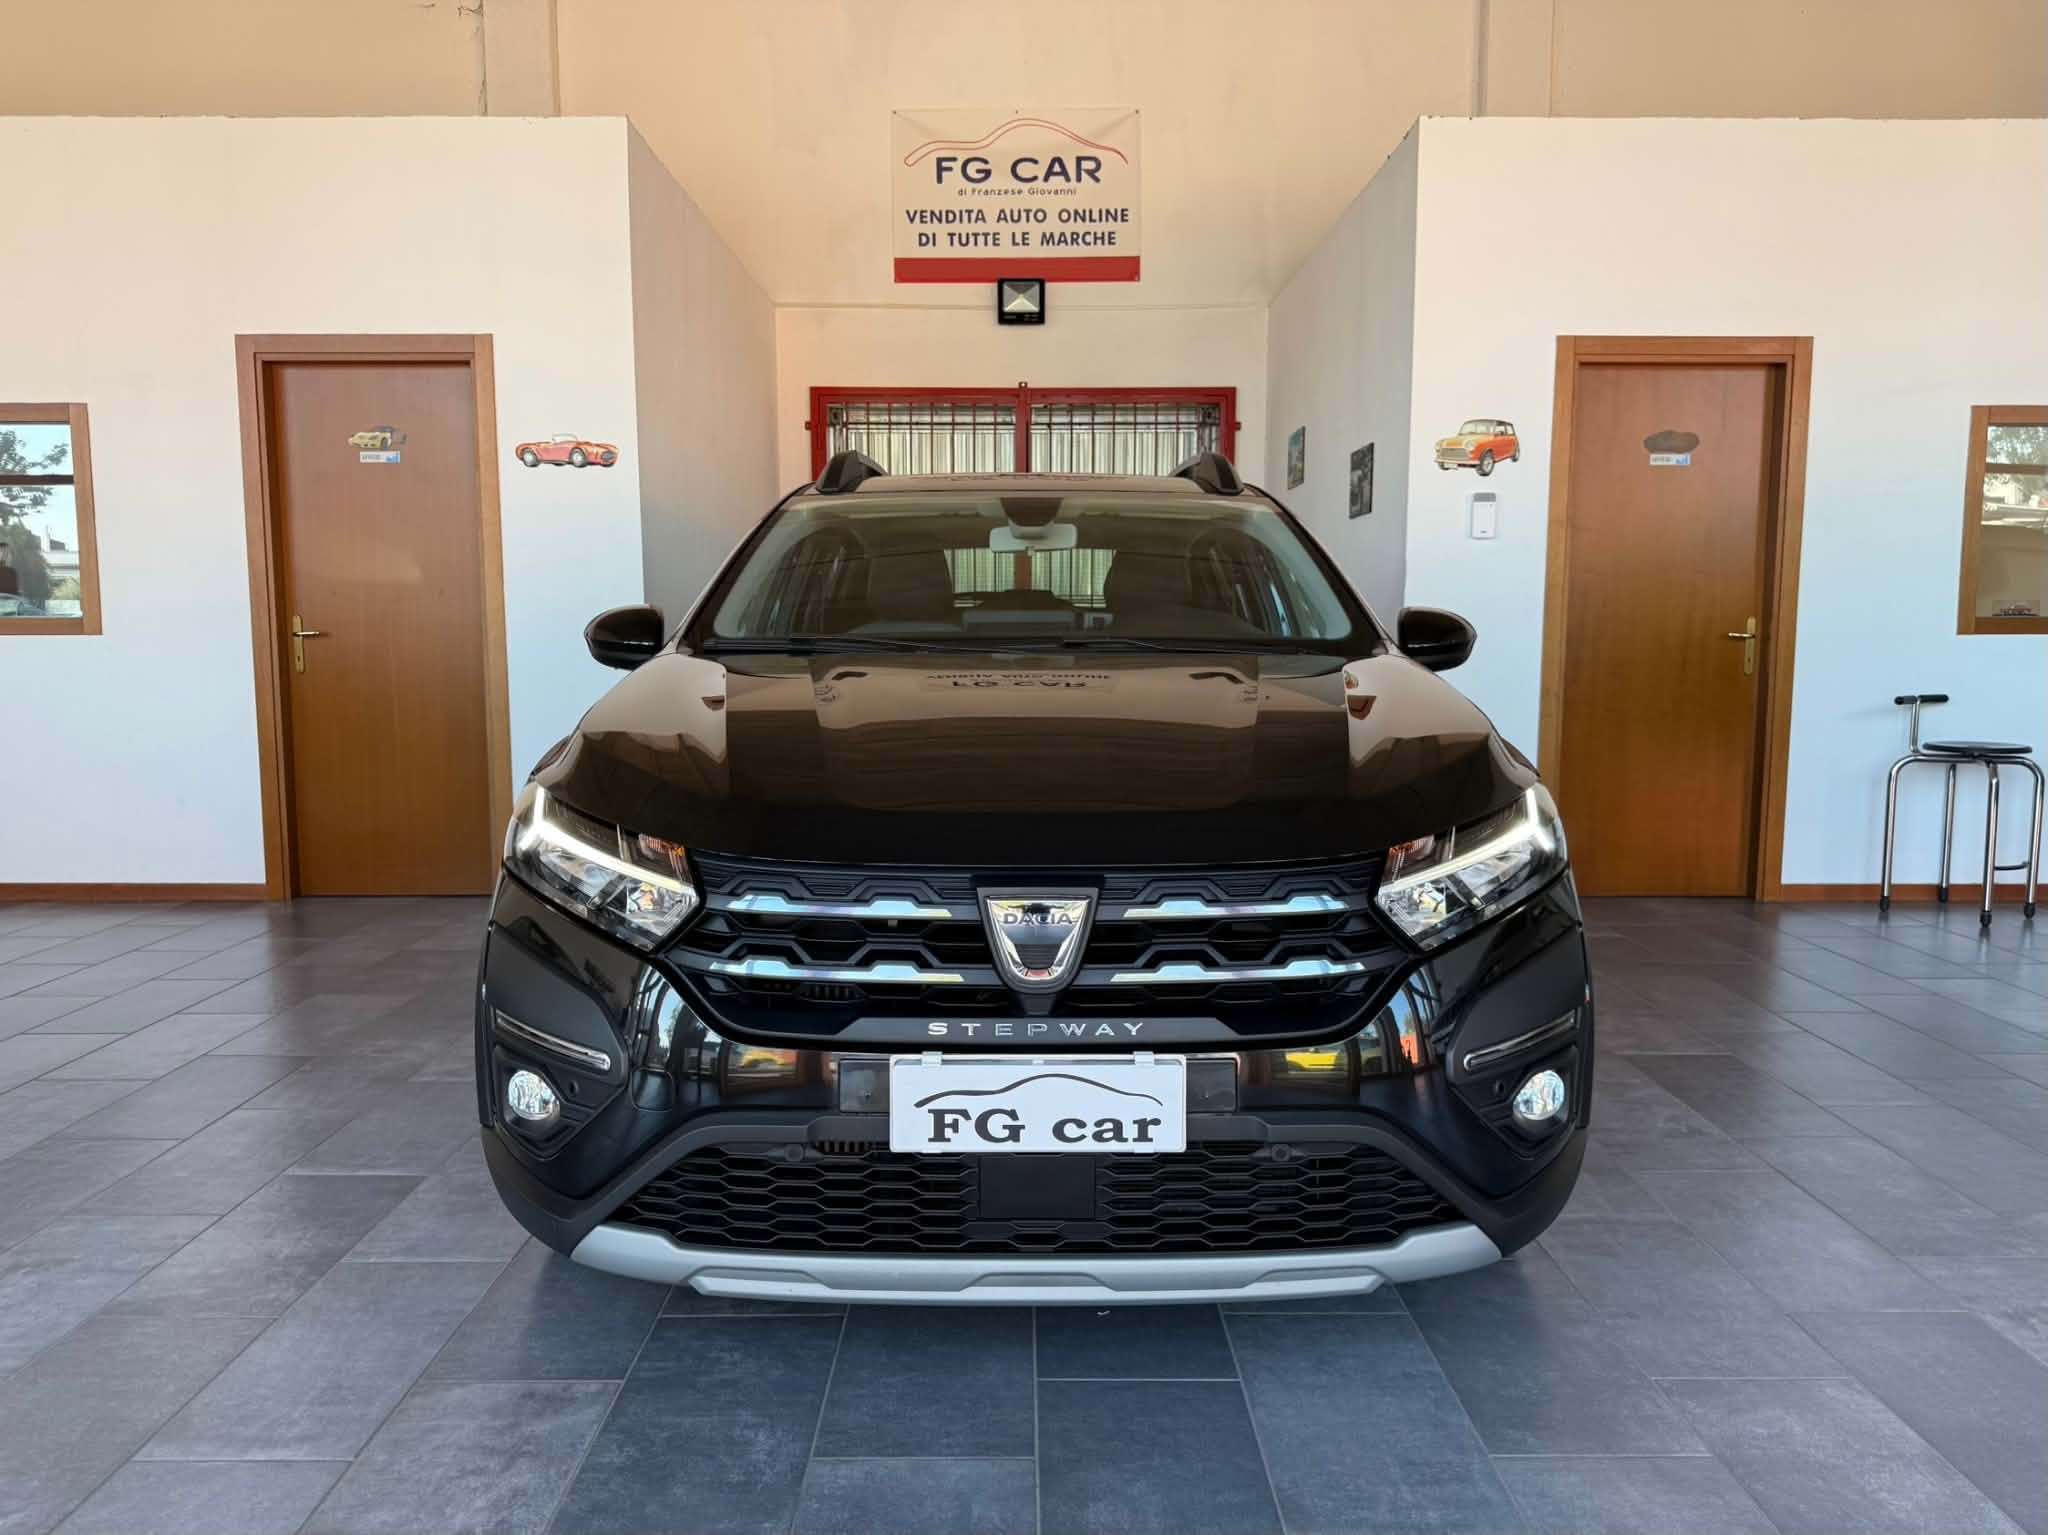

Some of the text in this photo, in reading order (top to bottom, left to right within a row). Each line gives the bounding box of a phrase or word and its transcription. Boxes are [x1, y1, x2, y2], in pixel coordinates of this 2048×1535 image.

[935, 155, 1102, 184] FG CAR
[958, 187, 1077, 196] di Franzese Giovanni
[906, 208, 1129, 224] VENDITA AUTO ONLINE
[918, 231, 1117, 247] DI TUTTE LE MARCHE
[1002, 912, 1073, 925] DACIA
[927, 1022, 1146, 1037] STEPWAY
[927, 1108, 1162, 1144] FG car
